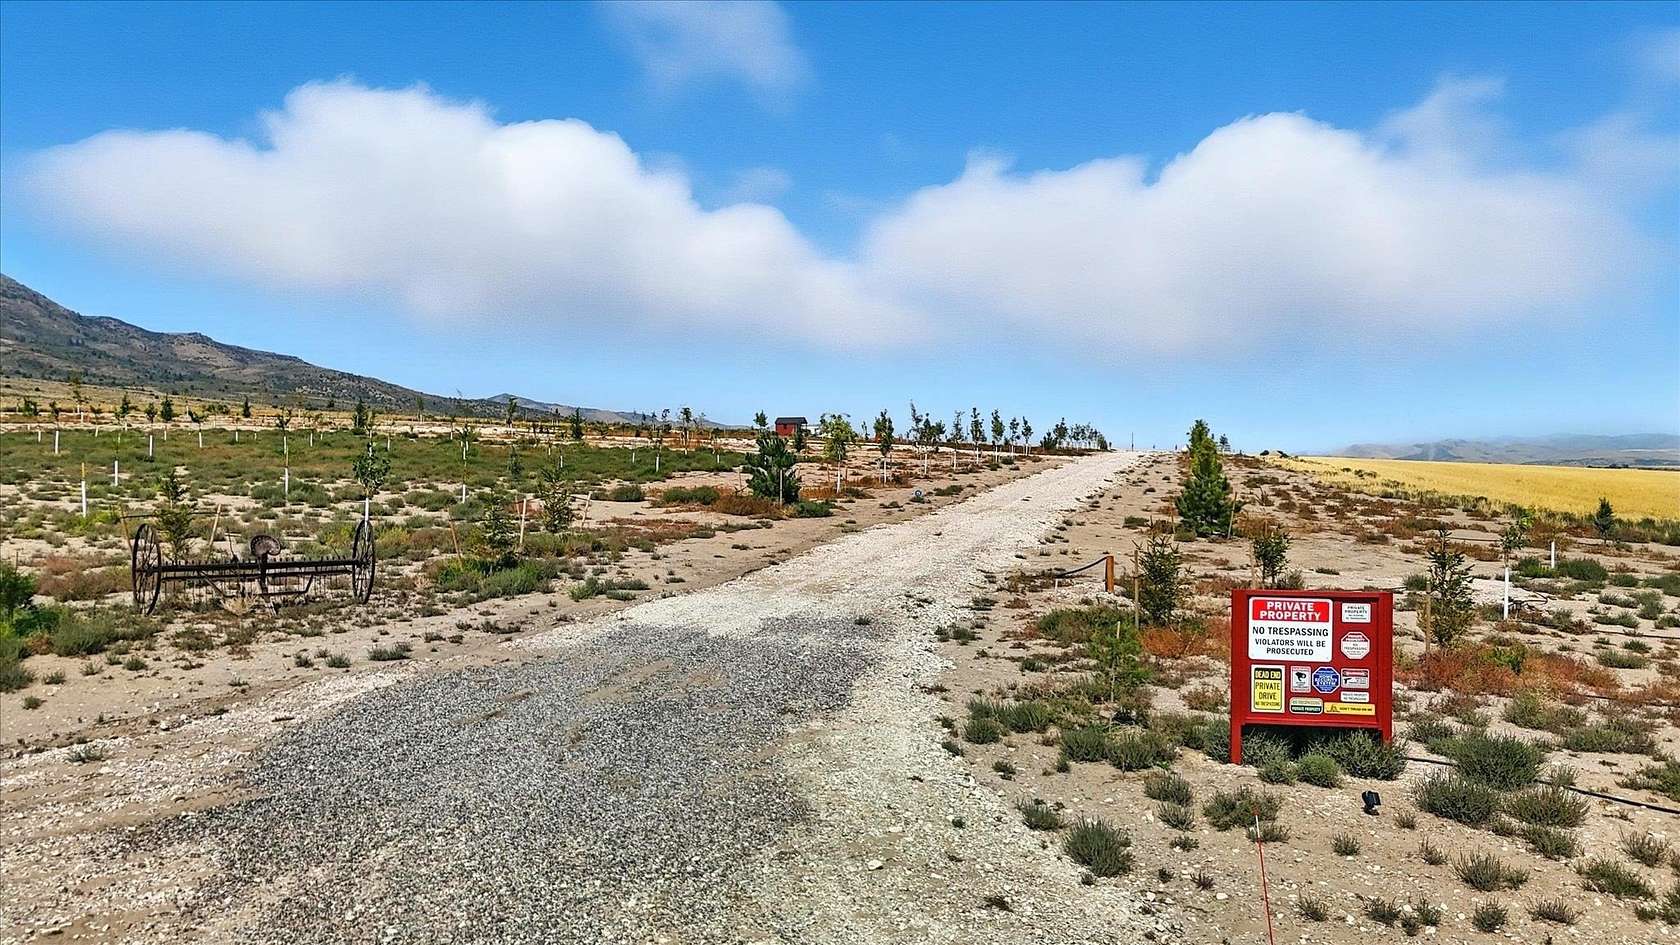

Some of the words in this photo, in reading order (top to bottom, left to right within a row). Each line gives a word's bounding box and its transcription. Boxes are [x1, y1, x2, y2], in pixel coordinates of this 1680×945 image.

[1266, 601, 1315, 611] PRIVATE
[1259, 611, 1321, 621] PROPERTY
[1252, 626, 1265, 635] NO
[1268, 627, 1329, 637] TRESPASSING
[1255, 638, 1295, 647] VIOLATORS
[1296, 639, 1314, 647] WILL
[1316, 640, 1326, 648] BE
[1266, 647, 1314, 656] PROSECUTED
[1255, 670, 1269, 679] DEAD
[1270, 671, 1281, 679] END
[1255, 682, 1280, 690] PRIVATE
[1258, 692, 1277, 700] DRIVE
